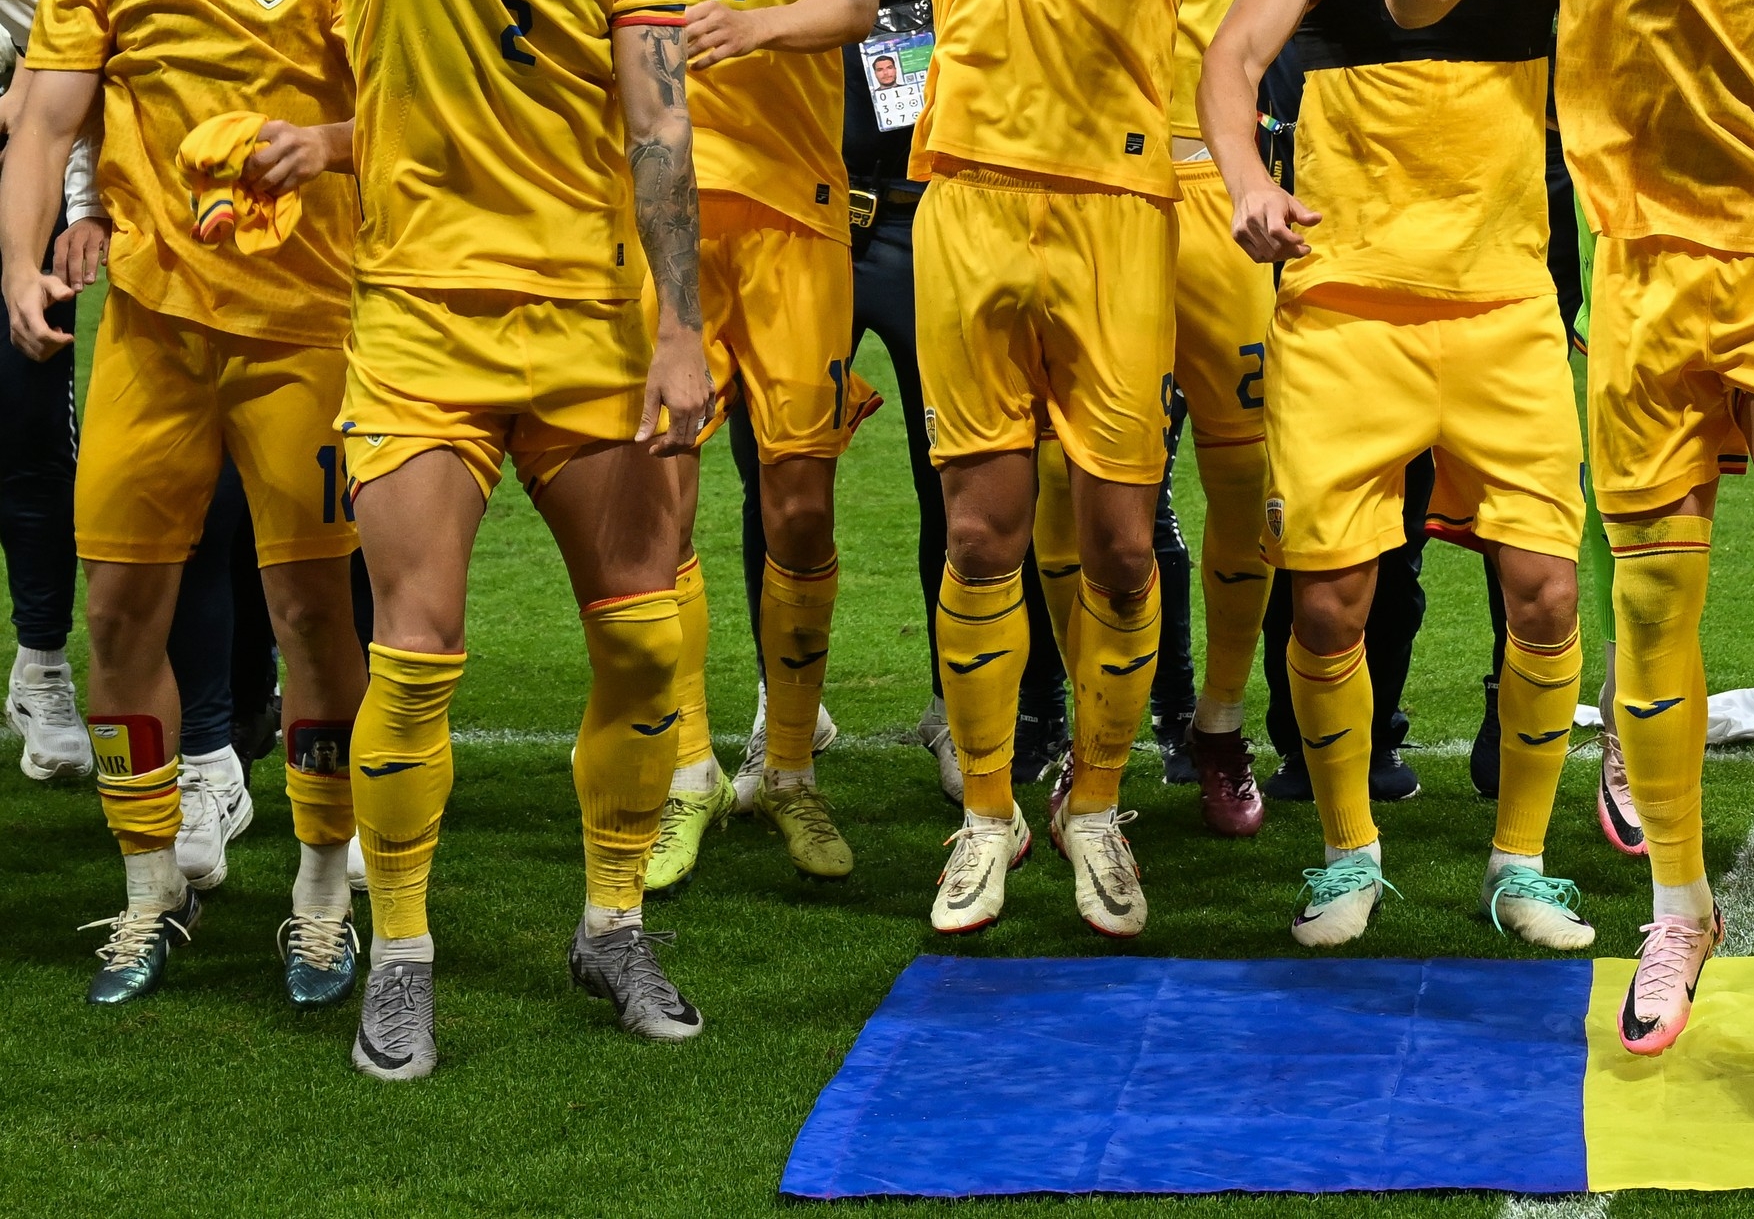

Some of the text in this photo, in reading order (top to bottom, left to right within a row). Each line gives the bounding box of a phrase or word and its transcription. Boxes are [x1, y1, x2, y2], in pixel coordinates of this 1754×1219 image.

[880, 92, 887, 101] 0
[909, 87, 914, 95] 2
[883, 105, 889, 113] 3
[886, 117, 892, 125] 6
